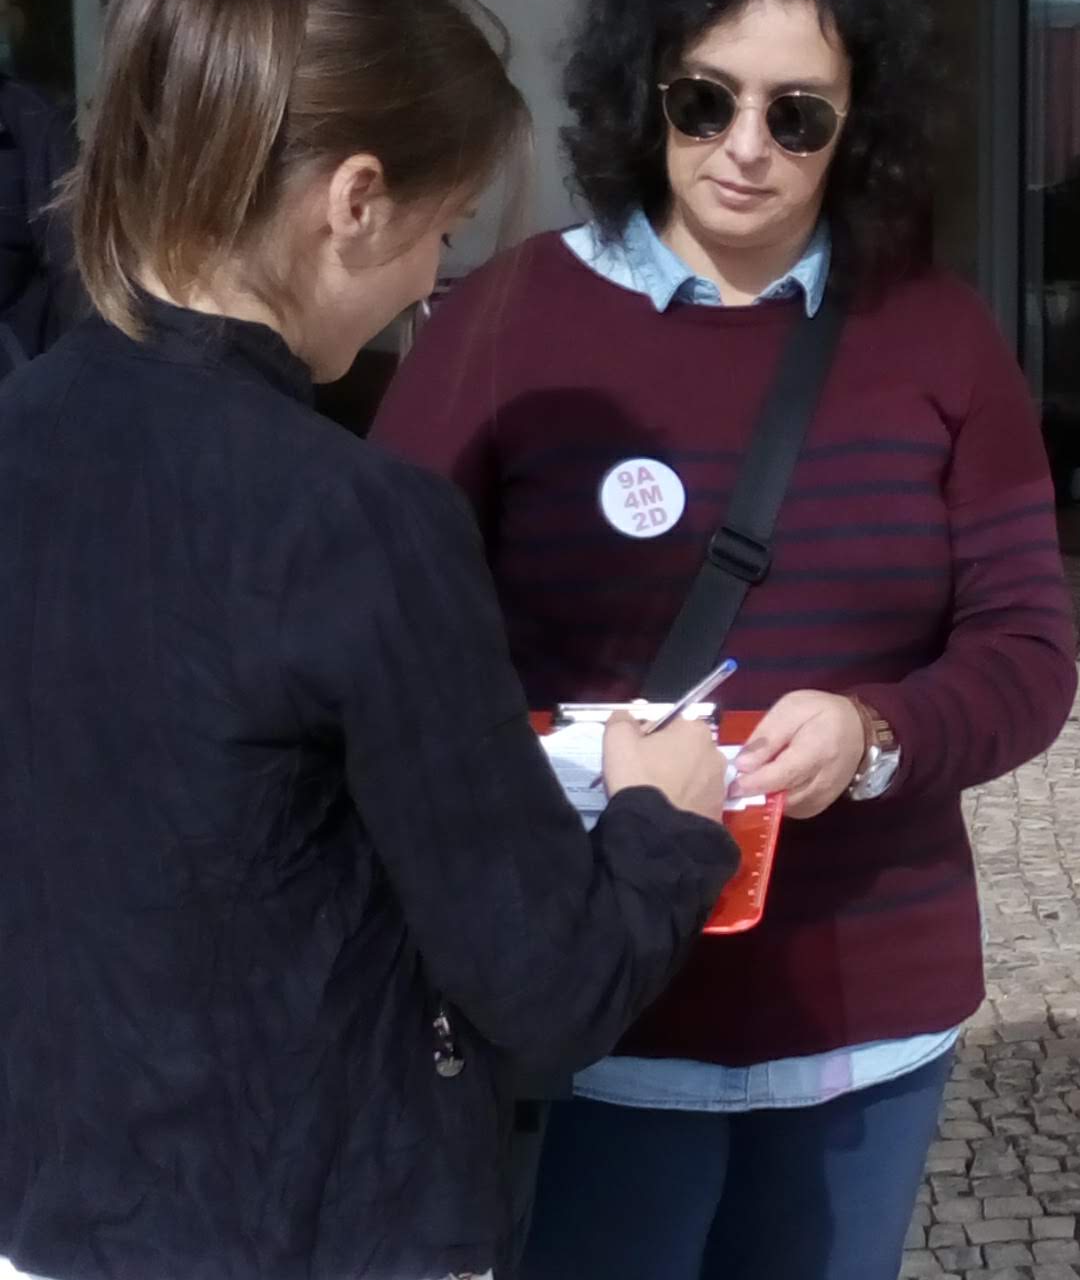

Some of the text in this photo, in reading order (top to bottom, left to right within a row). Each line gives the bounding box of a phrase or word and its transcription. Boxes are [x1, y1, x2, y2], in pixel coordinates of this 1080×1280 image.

[617, 465, 657, 490] 9A
[623, 486, 664, 510] 4M
[630, 507, 669, 533] 2D
